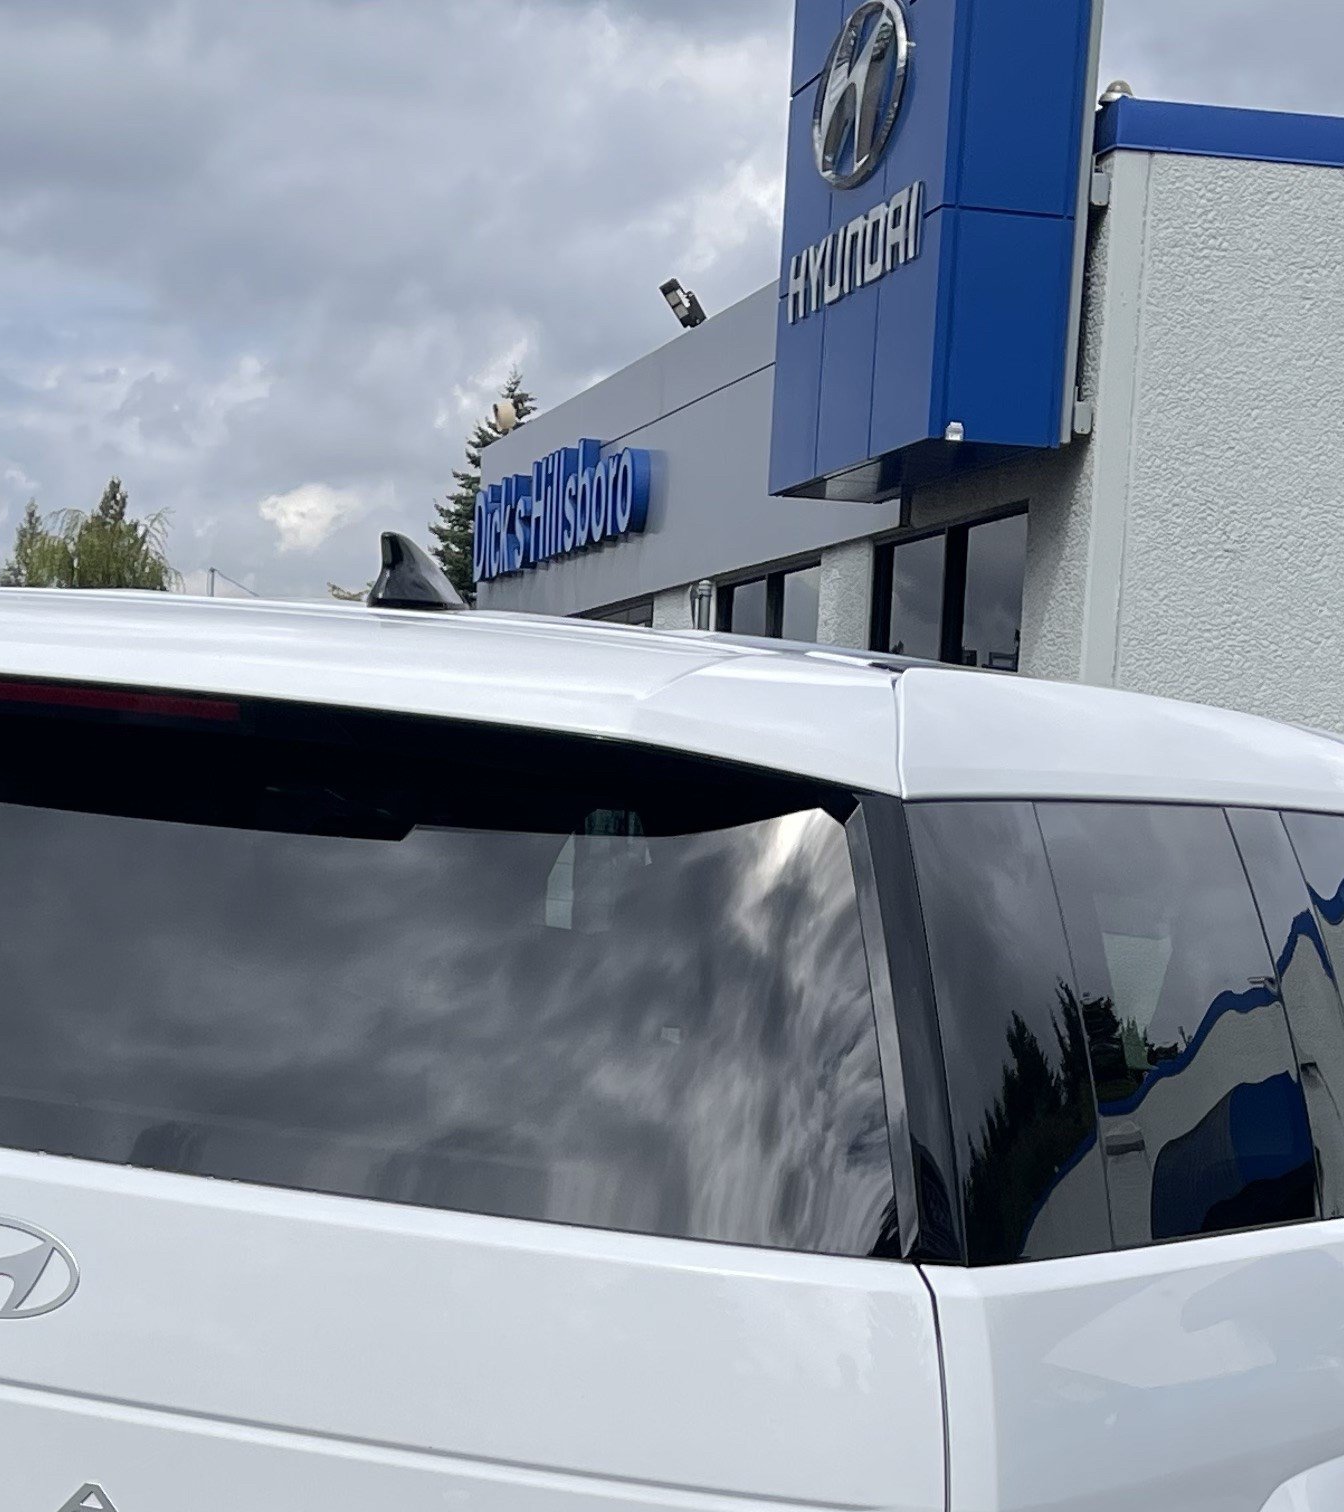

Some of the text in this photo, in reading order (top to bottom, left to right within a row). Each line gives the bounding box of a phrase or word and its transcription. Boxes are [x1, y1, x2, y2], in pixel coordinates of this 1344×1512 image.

[788, 181, 922, 325] HYUNDAI
[473, 438, 636, 583] Dick's Hillsboro
